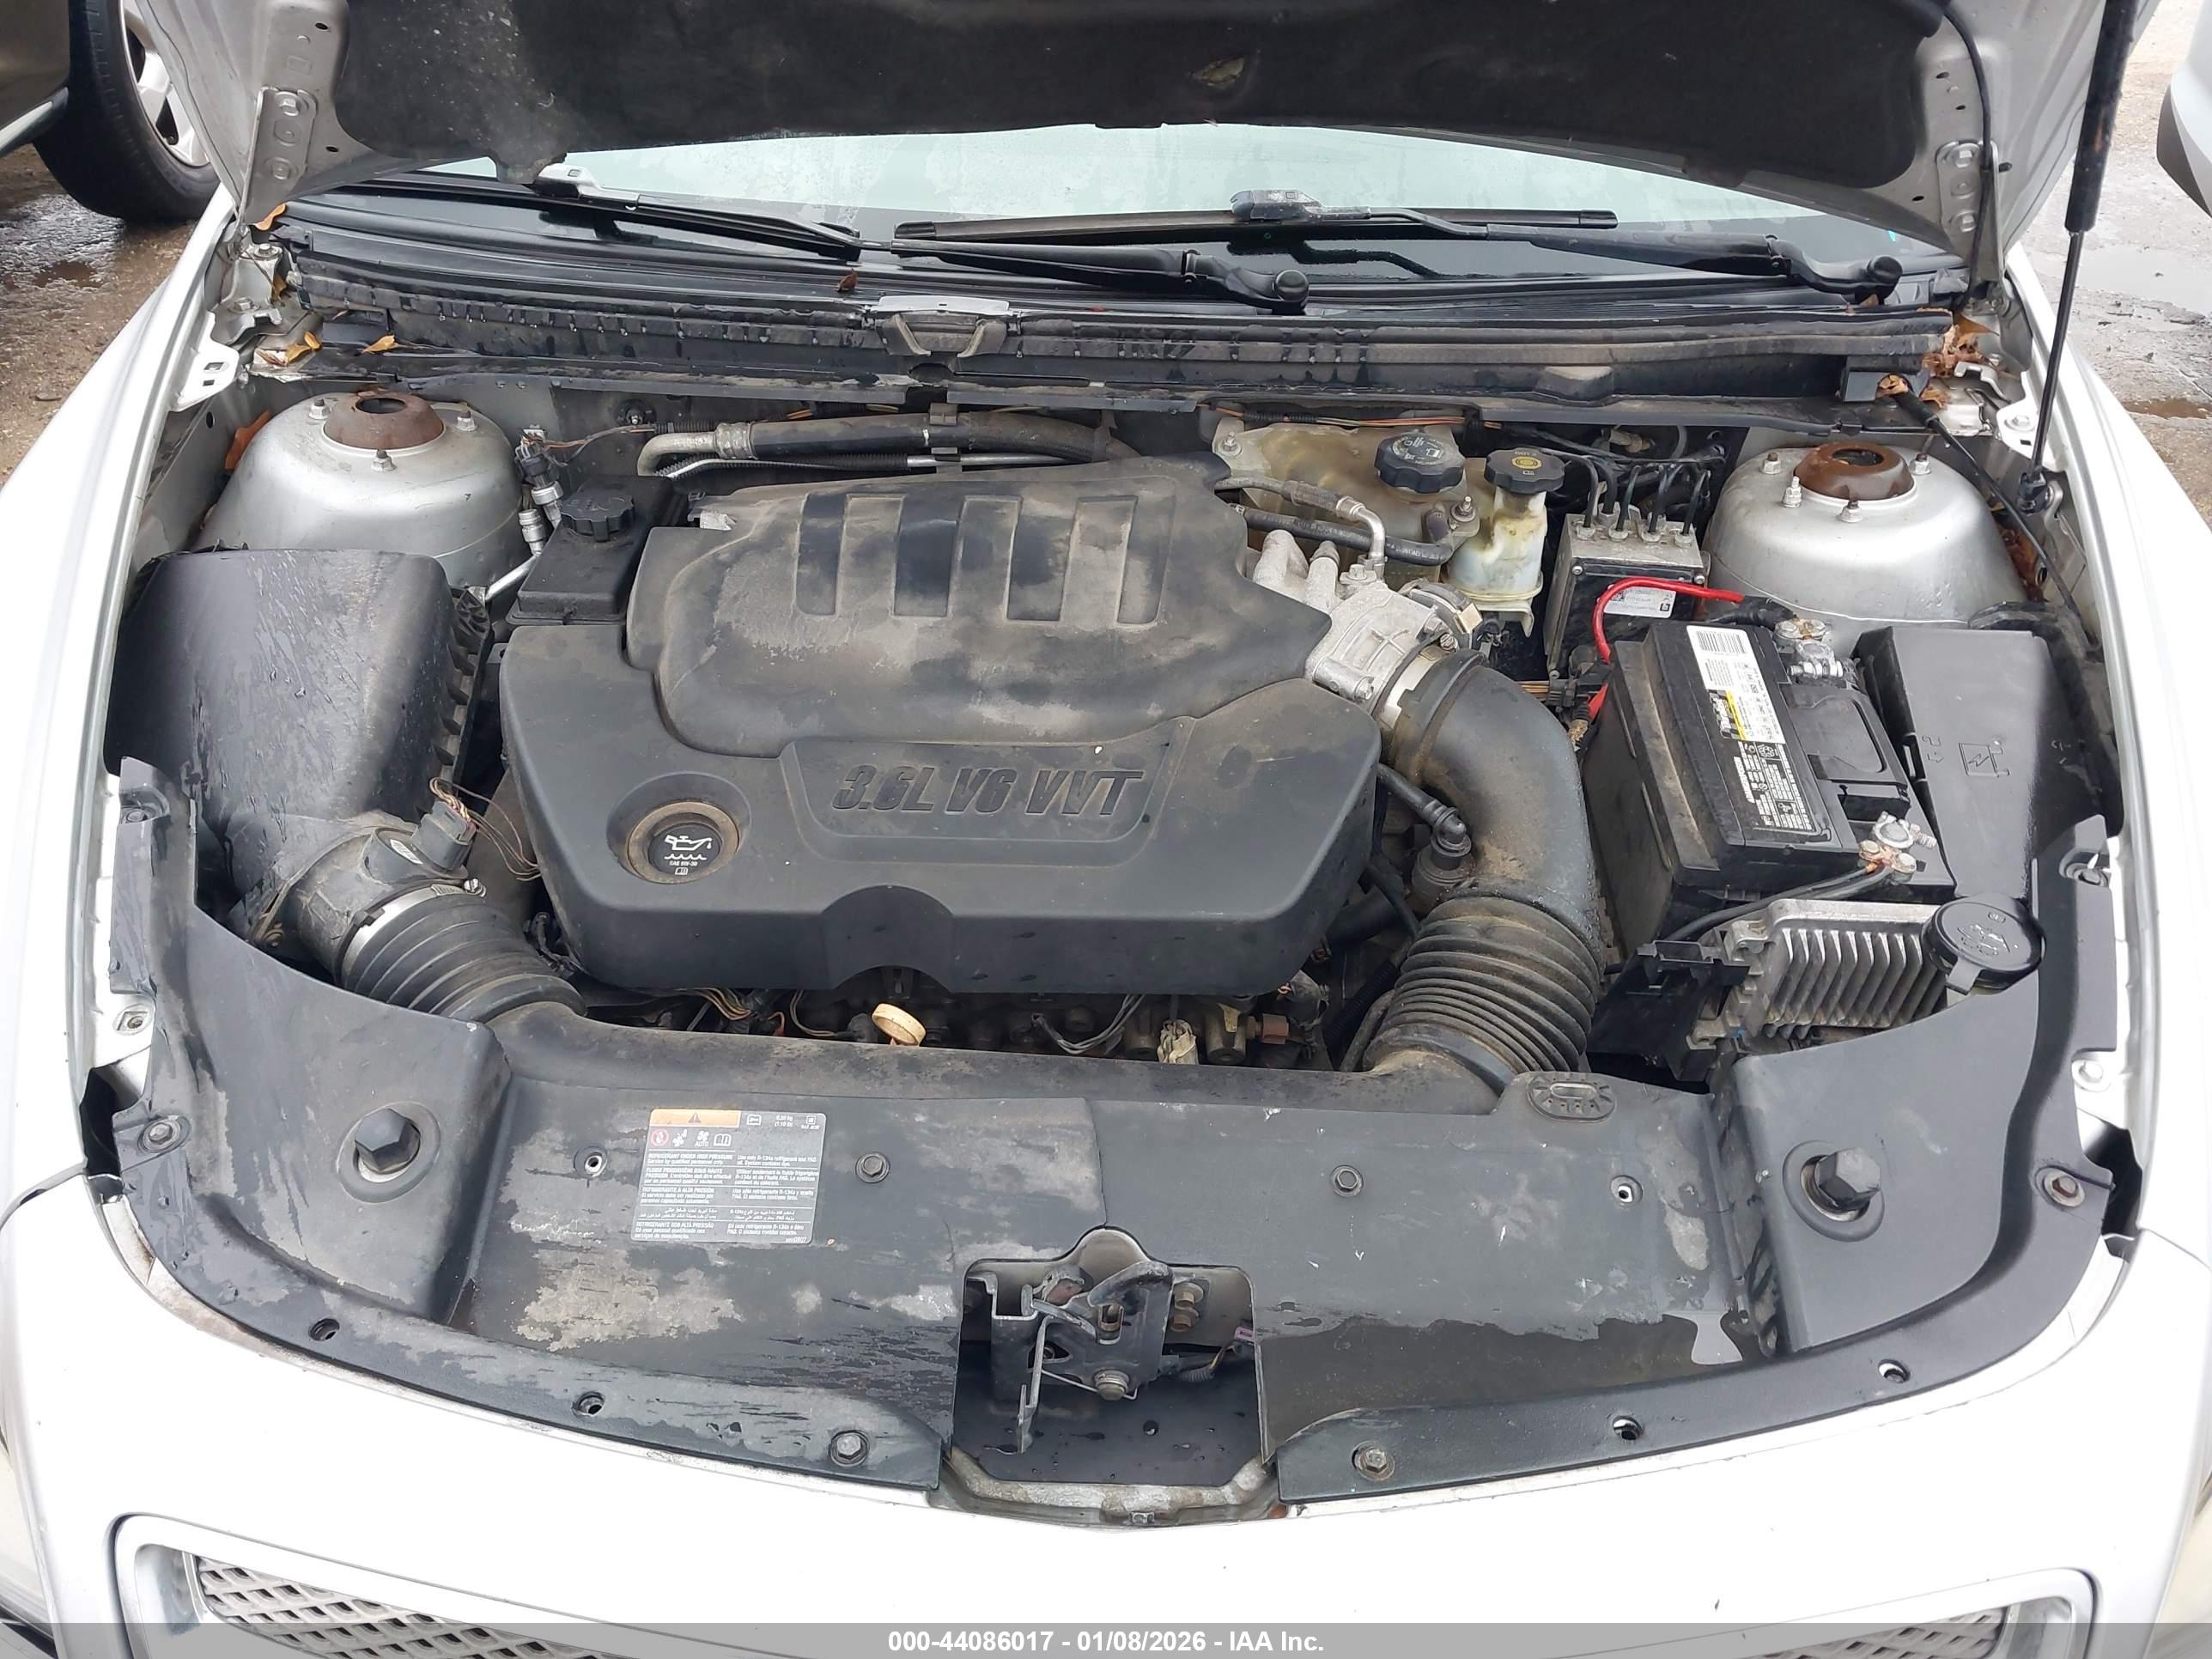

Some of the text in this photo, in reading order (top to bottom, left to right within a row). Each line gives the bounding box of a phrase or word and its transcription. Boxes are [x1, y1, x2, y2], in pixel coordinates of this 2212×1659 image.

[832, 764, 1145, 816] 3.6L V6 VVT
